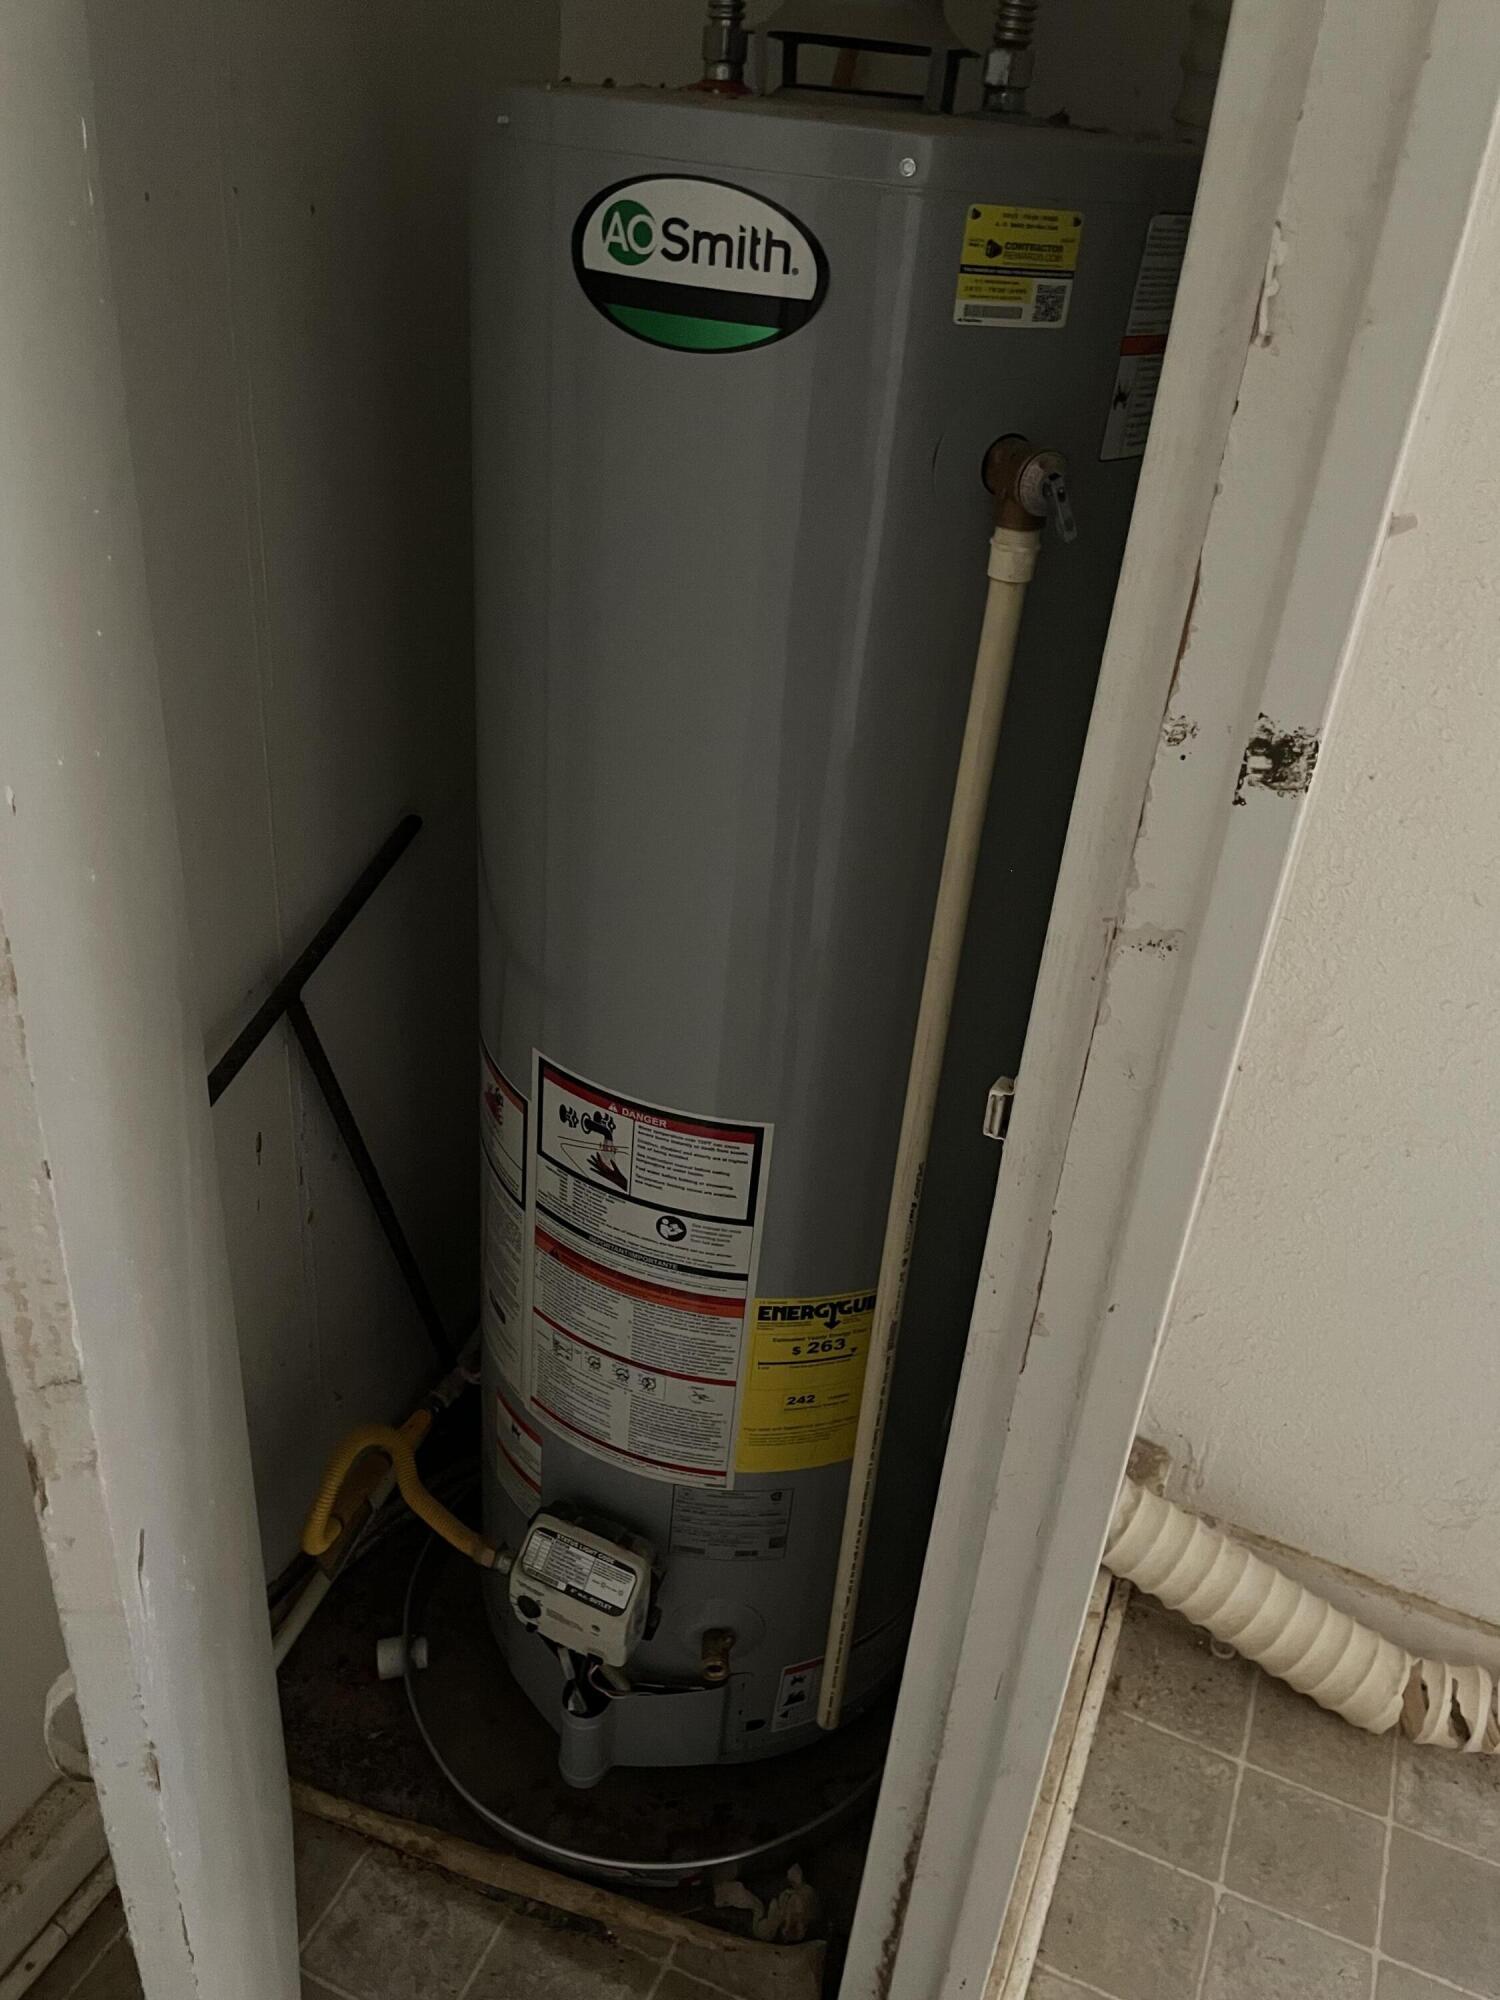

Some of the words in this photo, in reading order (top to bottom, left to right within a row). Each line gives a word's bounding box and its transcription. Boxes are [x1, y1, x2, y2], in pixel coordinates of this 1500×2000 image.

[661, 217, 791, 275] Smith
[621, 1107, 668, 1128] DANGER
[806, 1338, 846, 1354] 263
[786, 1394, 816, 1406] 242
